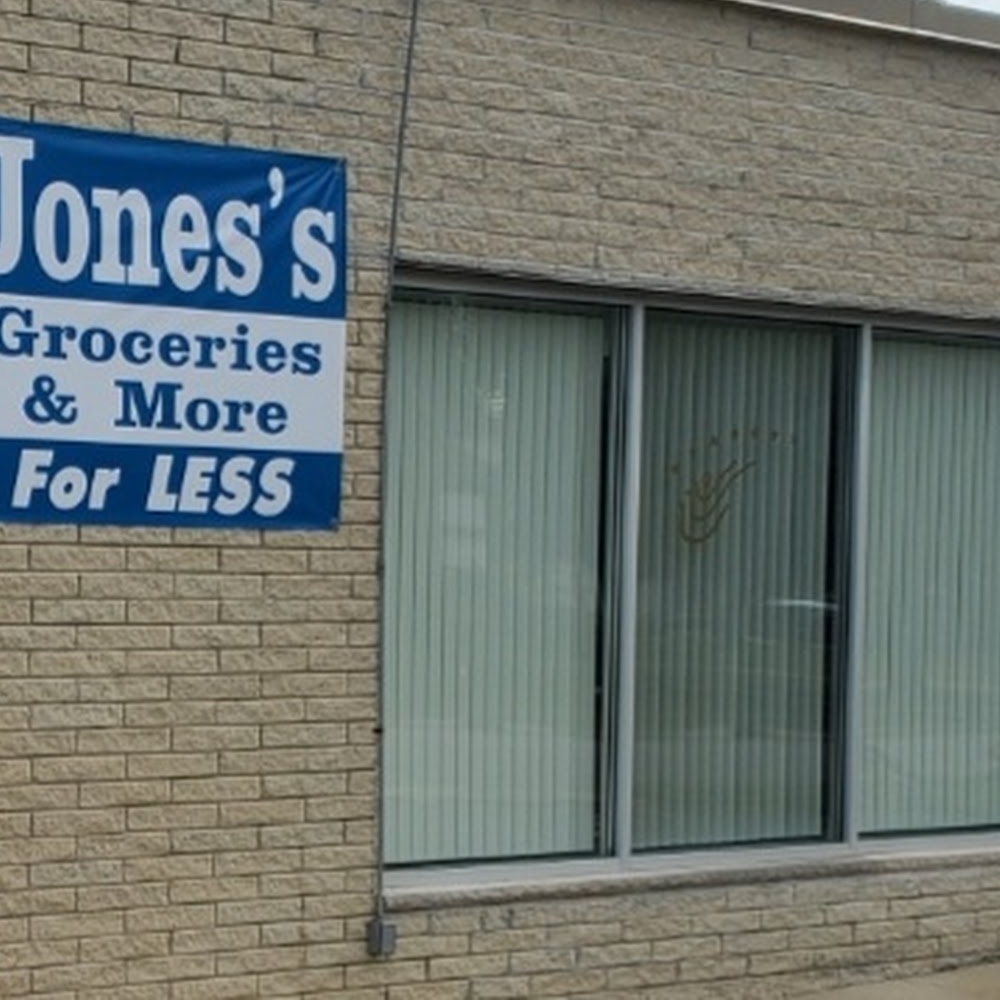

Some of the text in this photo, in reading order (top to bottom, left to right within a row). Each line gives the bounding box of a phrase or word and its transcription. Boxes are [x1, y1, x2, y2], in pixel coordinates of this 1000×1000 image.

[23, 375, 288, 434] & More
[11, 449, 295, 517] For LESS
